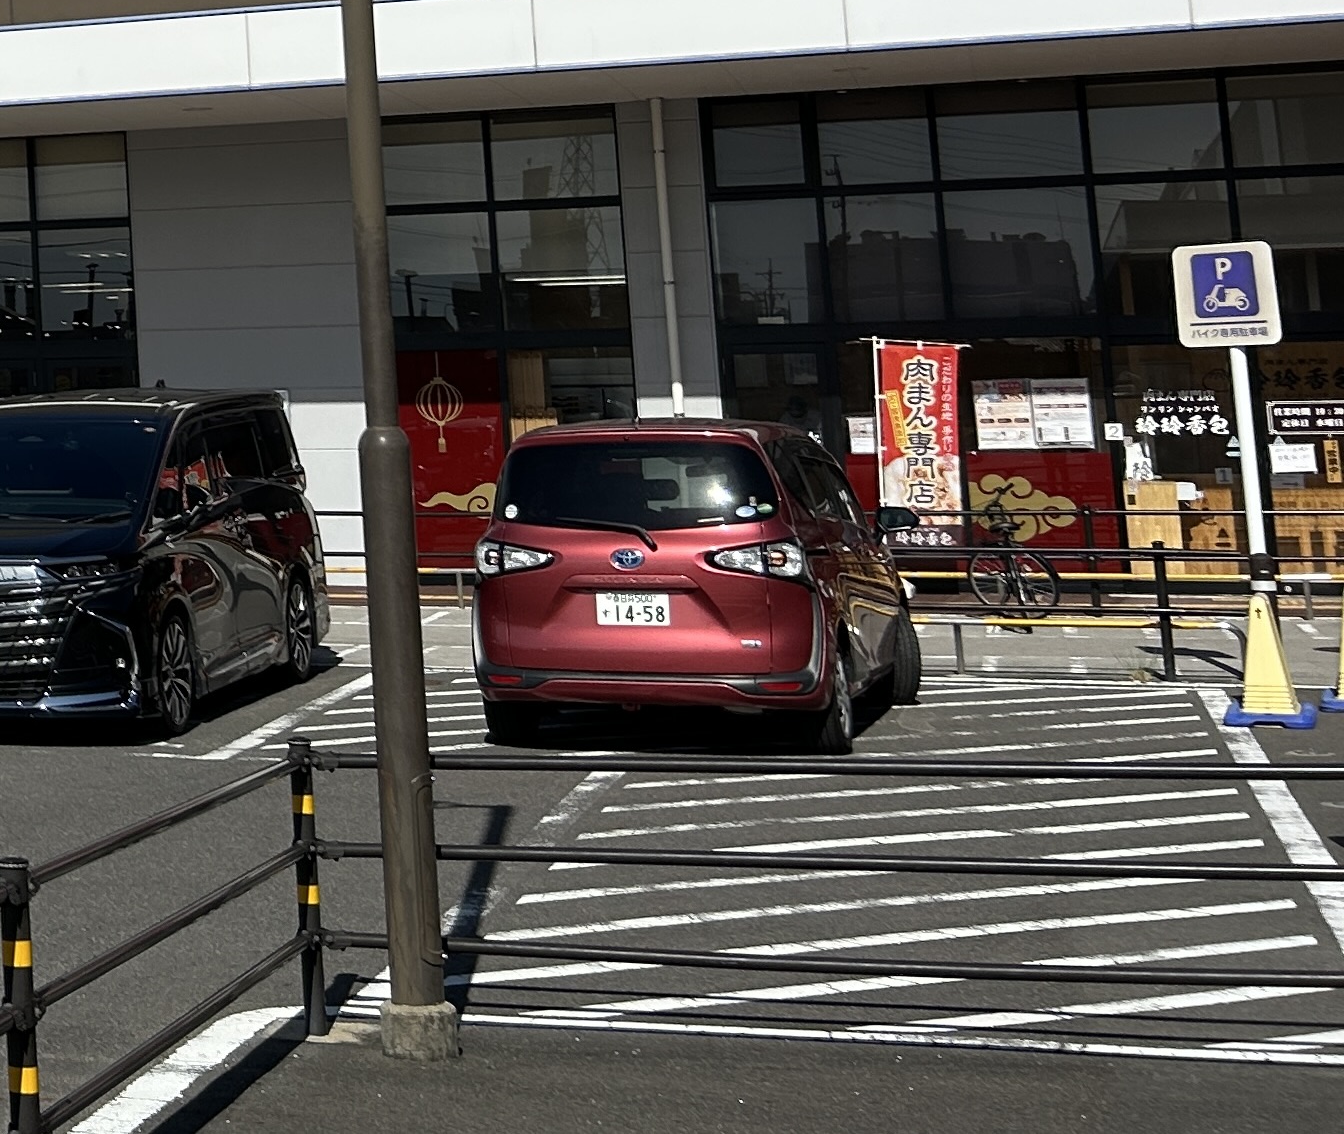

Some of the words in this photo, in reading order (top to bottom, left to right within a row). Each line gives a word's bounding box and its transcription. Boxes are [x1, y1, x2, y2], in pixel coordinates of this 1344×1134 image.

[1215, 257, 1232, 280] P
[1191, 327, 1269, 338] バイク専用駐車場
[901, 356, 939, 506] 肉まん専門店
[1108, 426, 1120, 439] 2
[1135, 415, 1230, 436] 玲玲香包
[615, 605, 665, 622] 14-58
